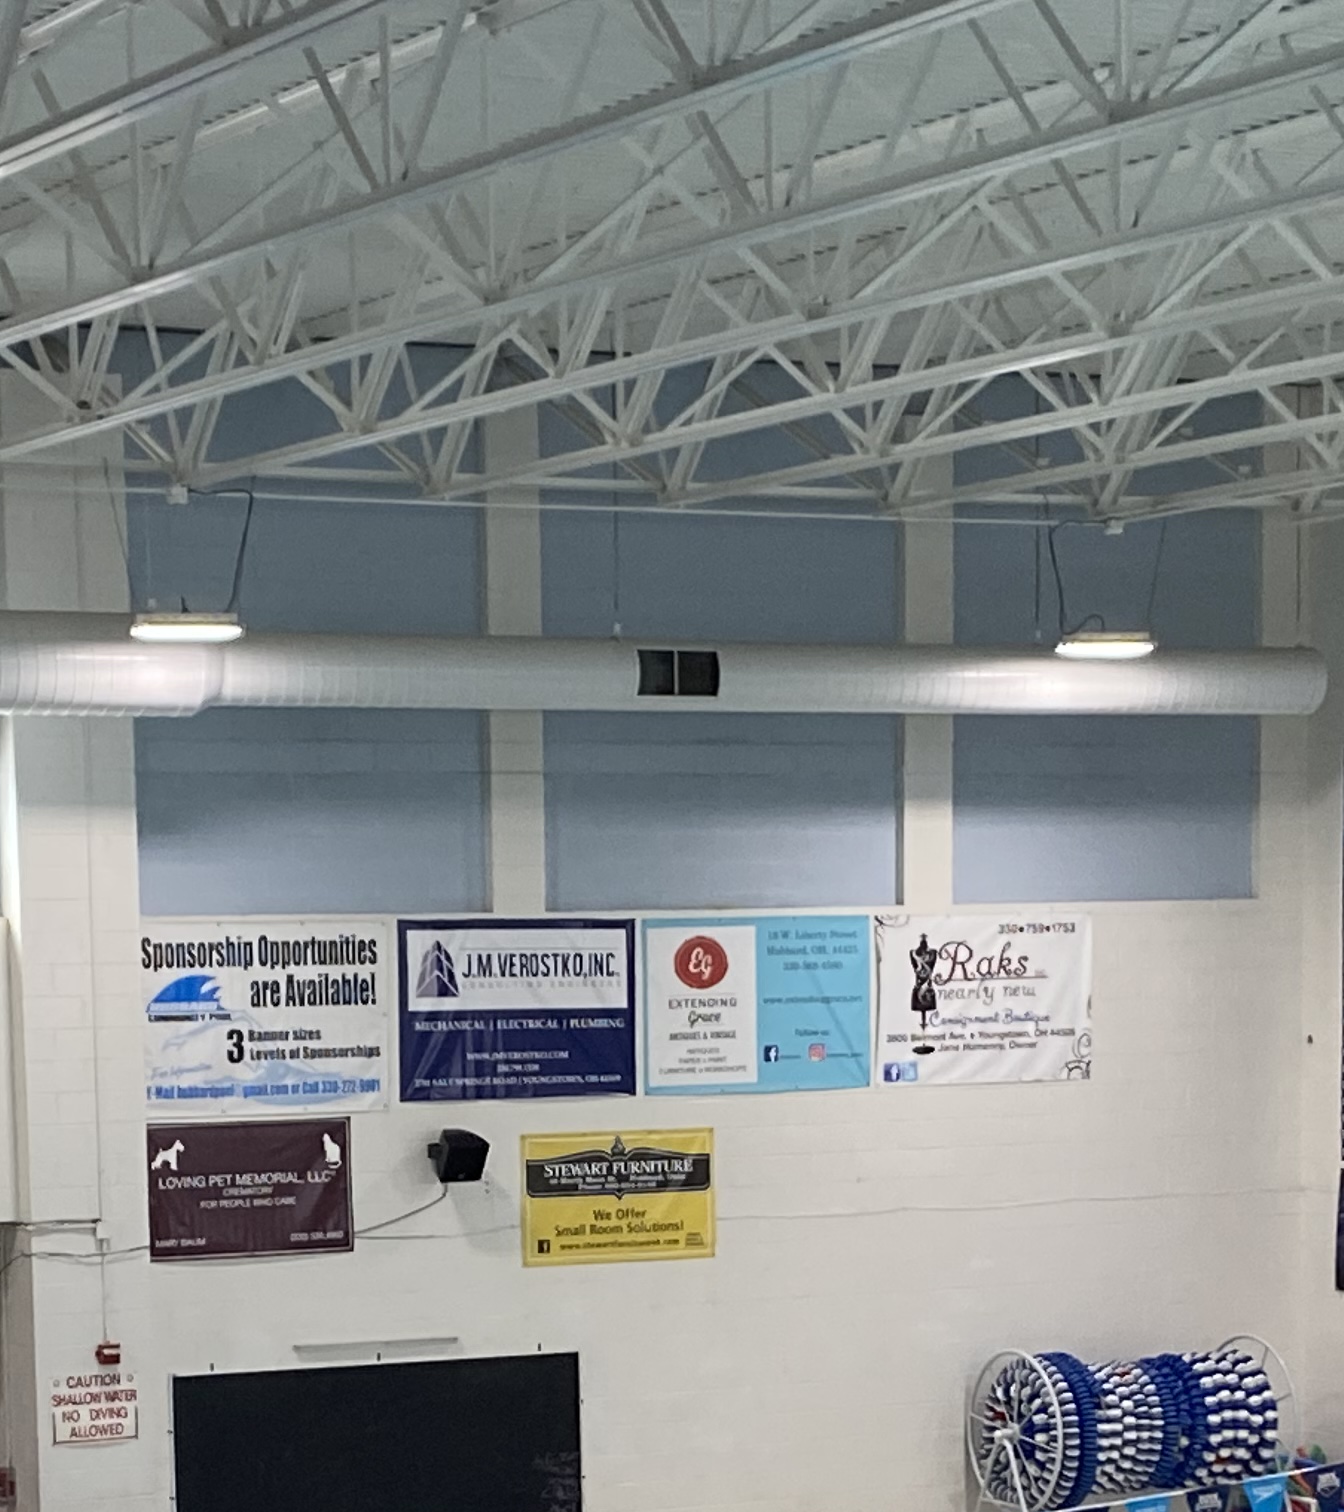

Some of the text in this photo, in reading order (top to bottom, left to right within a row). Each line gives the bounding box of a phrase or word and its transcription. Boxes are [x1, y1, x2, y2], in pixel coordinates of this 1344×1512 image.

[141, 934, 377, 971] Sponsorship Opportunities
[933, 940, 1029, 985] Raks
[250, 972, 376, 1008] are Available!
[669, 997, 737, 1010] EXTENDING
[415, 1018, 625, 1031] MECHANICAL ELECTRICAL PLUMBING
[248, 1028, 321, 1042] Banner sizes
[227, 1029, 244, 1063] 3
[250, 1044, 381, 1061] Levels of Sponsorships
[544, 1158, 693, 1178] STEWART FURNITURE
[159, 1175, 206, 1189] LOVING
[208, 1173, 233, 1188] PET
[307, 1171, 333, 1184] LLC
[593, 1208, 647, 1221] We Offer
[555, 1220, 684, 1236] Small Room Solutions!
[66, 1374, 120, 1389] CAUTION
[52, 1389, 137, 1407] SHALLOW WATER
[62, 1406, 128, 1422] NO DIVING
[70, 1423, 124, 1438] ALLOWED
